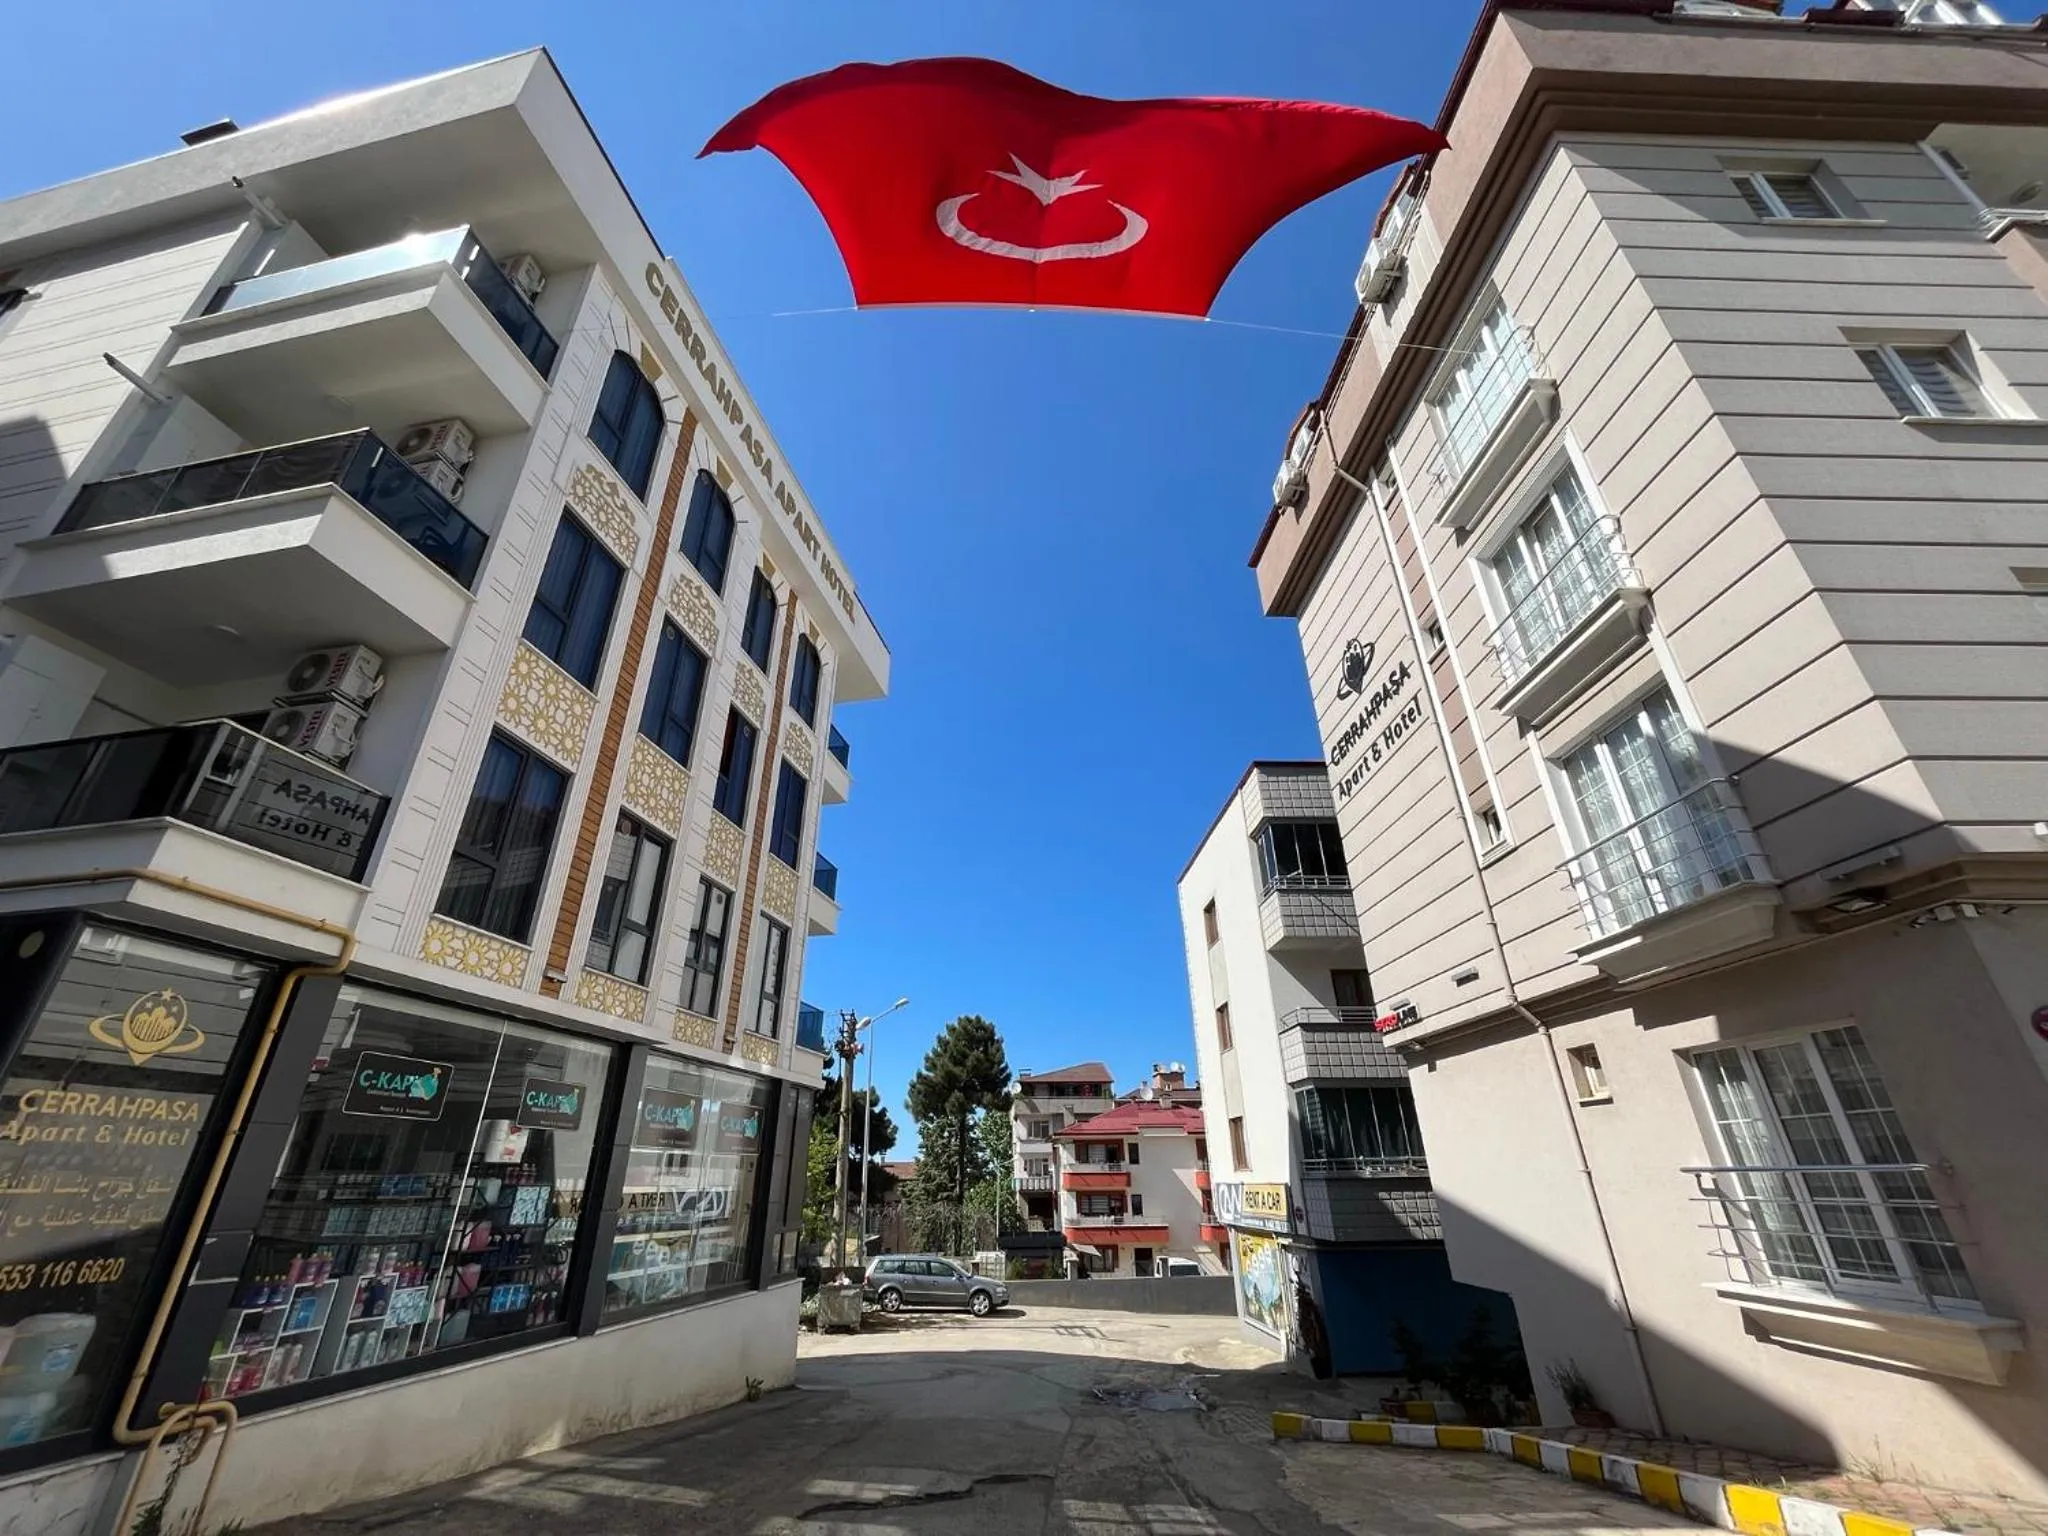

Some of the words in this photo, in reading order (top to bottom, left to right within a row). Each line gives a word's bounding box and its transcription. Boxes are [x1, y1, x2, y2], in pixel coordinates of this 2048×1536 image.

[645, 262, 773, 488] CERRAHPASA
[775, 480, 821, 562] APART
[820, 552, 855, 625] HOTEL
[1338, 756, 1371, 801] Apart
[1371, 742, 1382, 763] &
[1382, 694, 1422, 750] Hotel
[18, 1088, 199, 1122] CERRAHPASA
[0, 1119, 87, 1147] Apart
[95, 1124, 115, 1144] &
[123, 1127, 190, 1147] Hotel
[1245, 1190, 1260, 1208] RENT
[1262, 1191, 1268, 1207] A
[1267, 1191, 1281, 1211] CAR
[40, 1261, 77, 1288] 116
[76, 1257, 125, 1285] 6620
